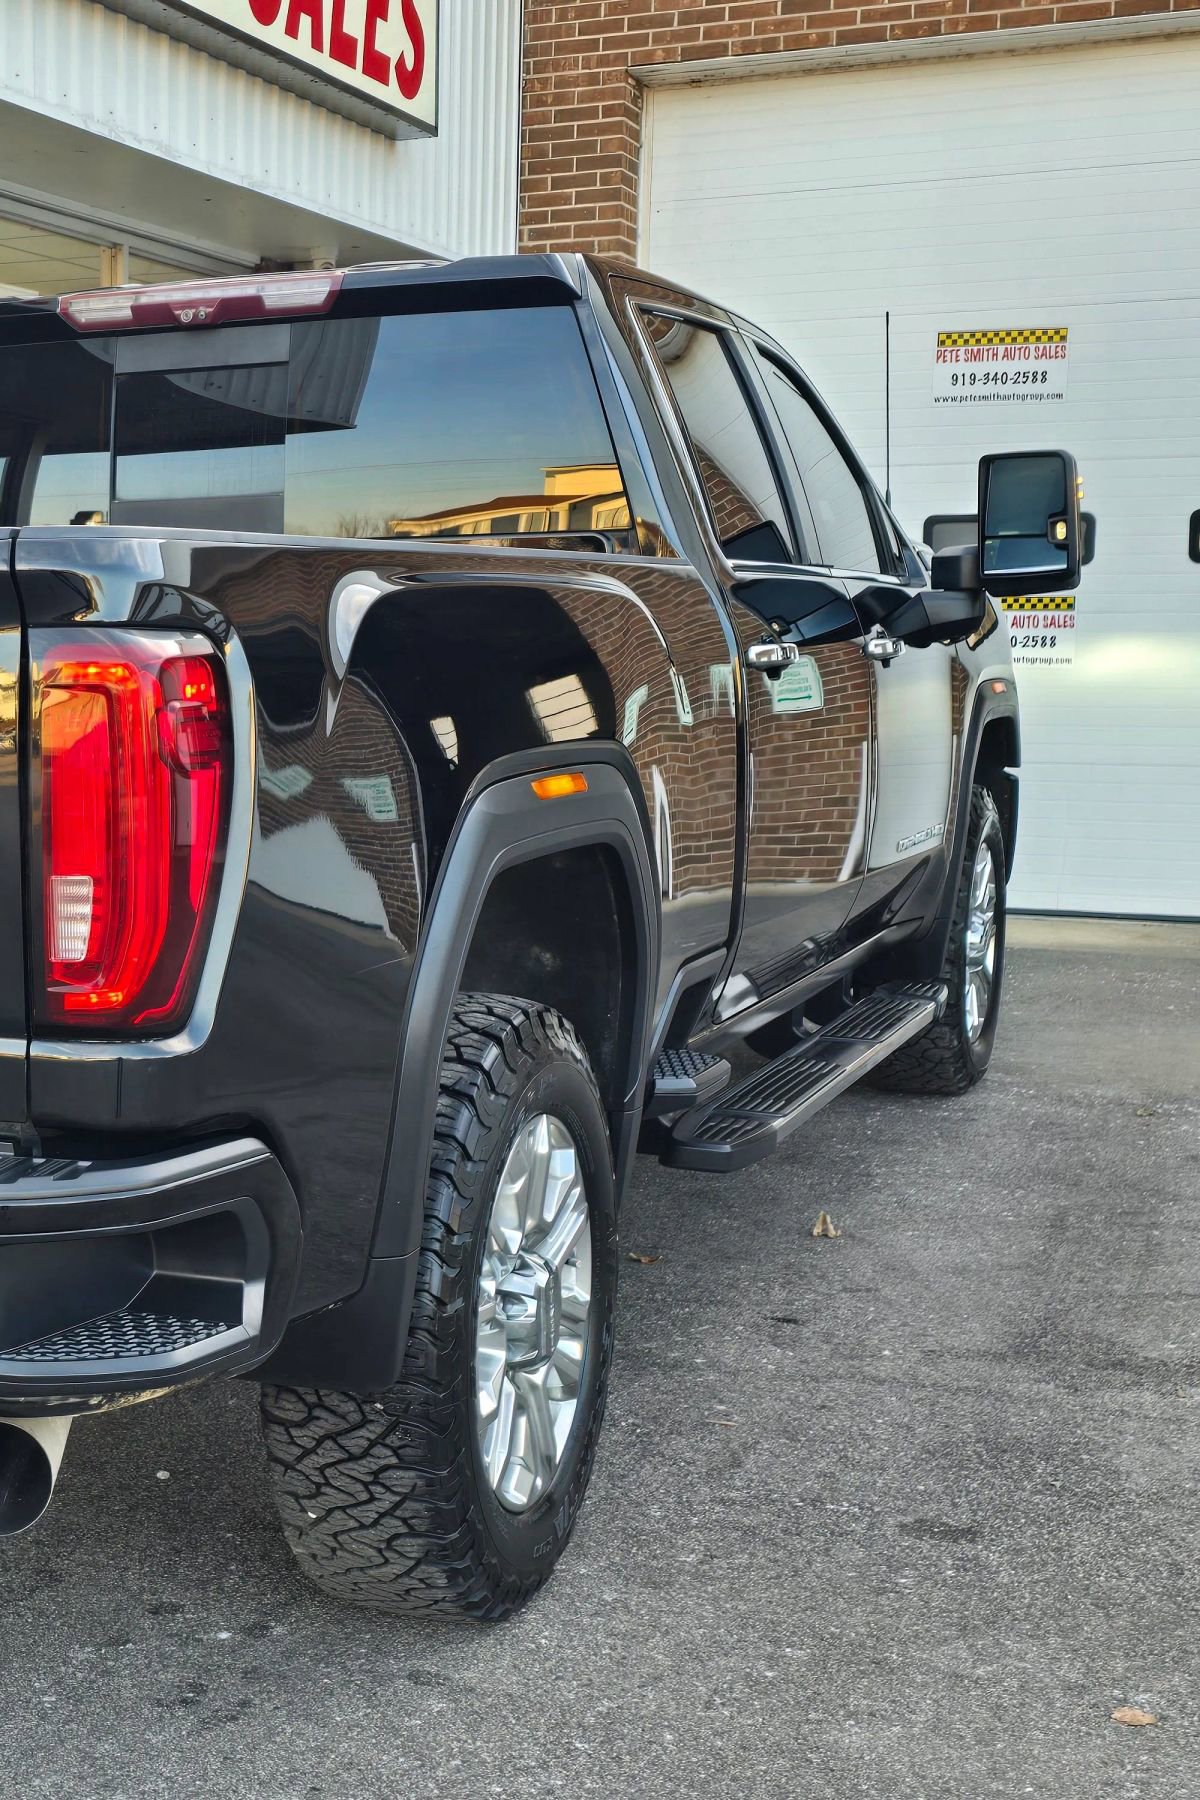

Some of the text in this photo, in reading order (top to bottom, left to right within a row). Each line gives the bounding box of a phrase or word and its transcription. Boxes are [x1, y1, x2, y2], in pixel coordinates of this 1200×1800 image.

[248, 0, 426, 100] LES
[935, 344, 1068, 364] PETE SMITH AUTO SALES
[951, 370, 1048, 387] 919-340-2588
[1010, 613, 1075, 629] AUTO SALES
[1010, 635, 1057, 649] 0-2588
